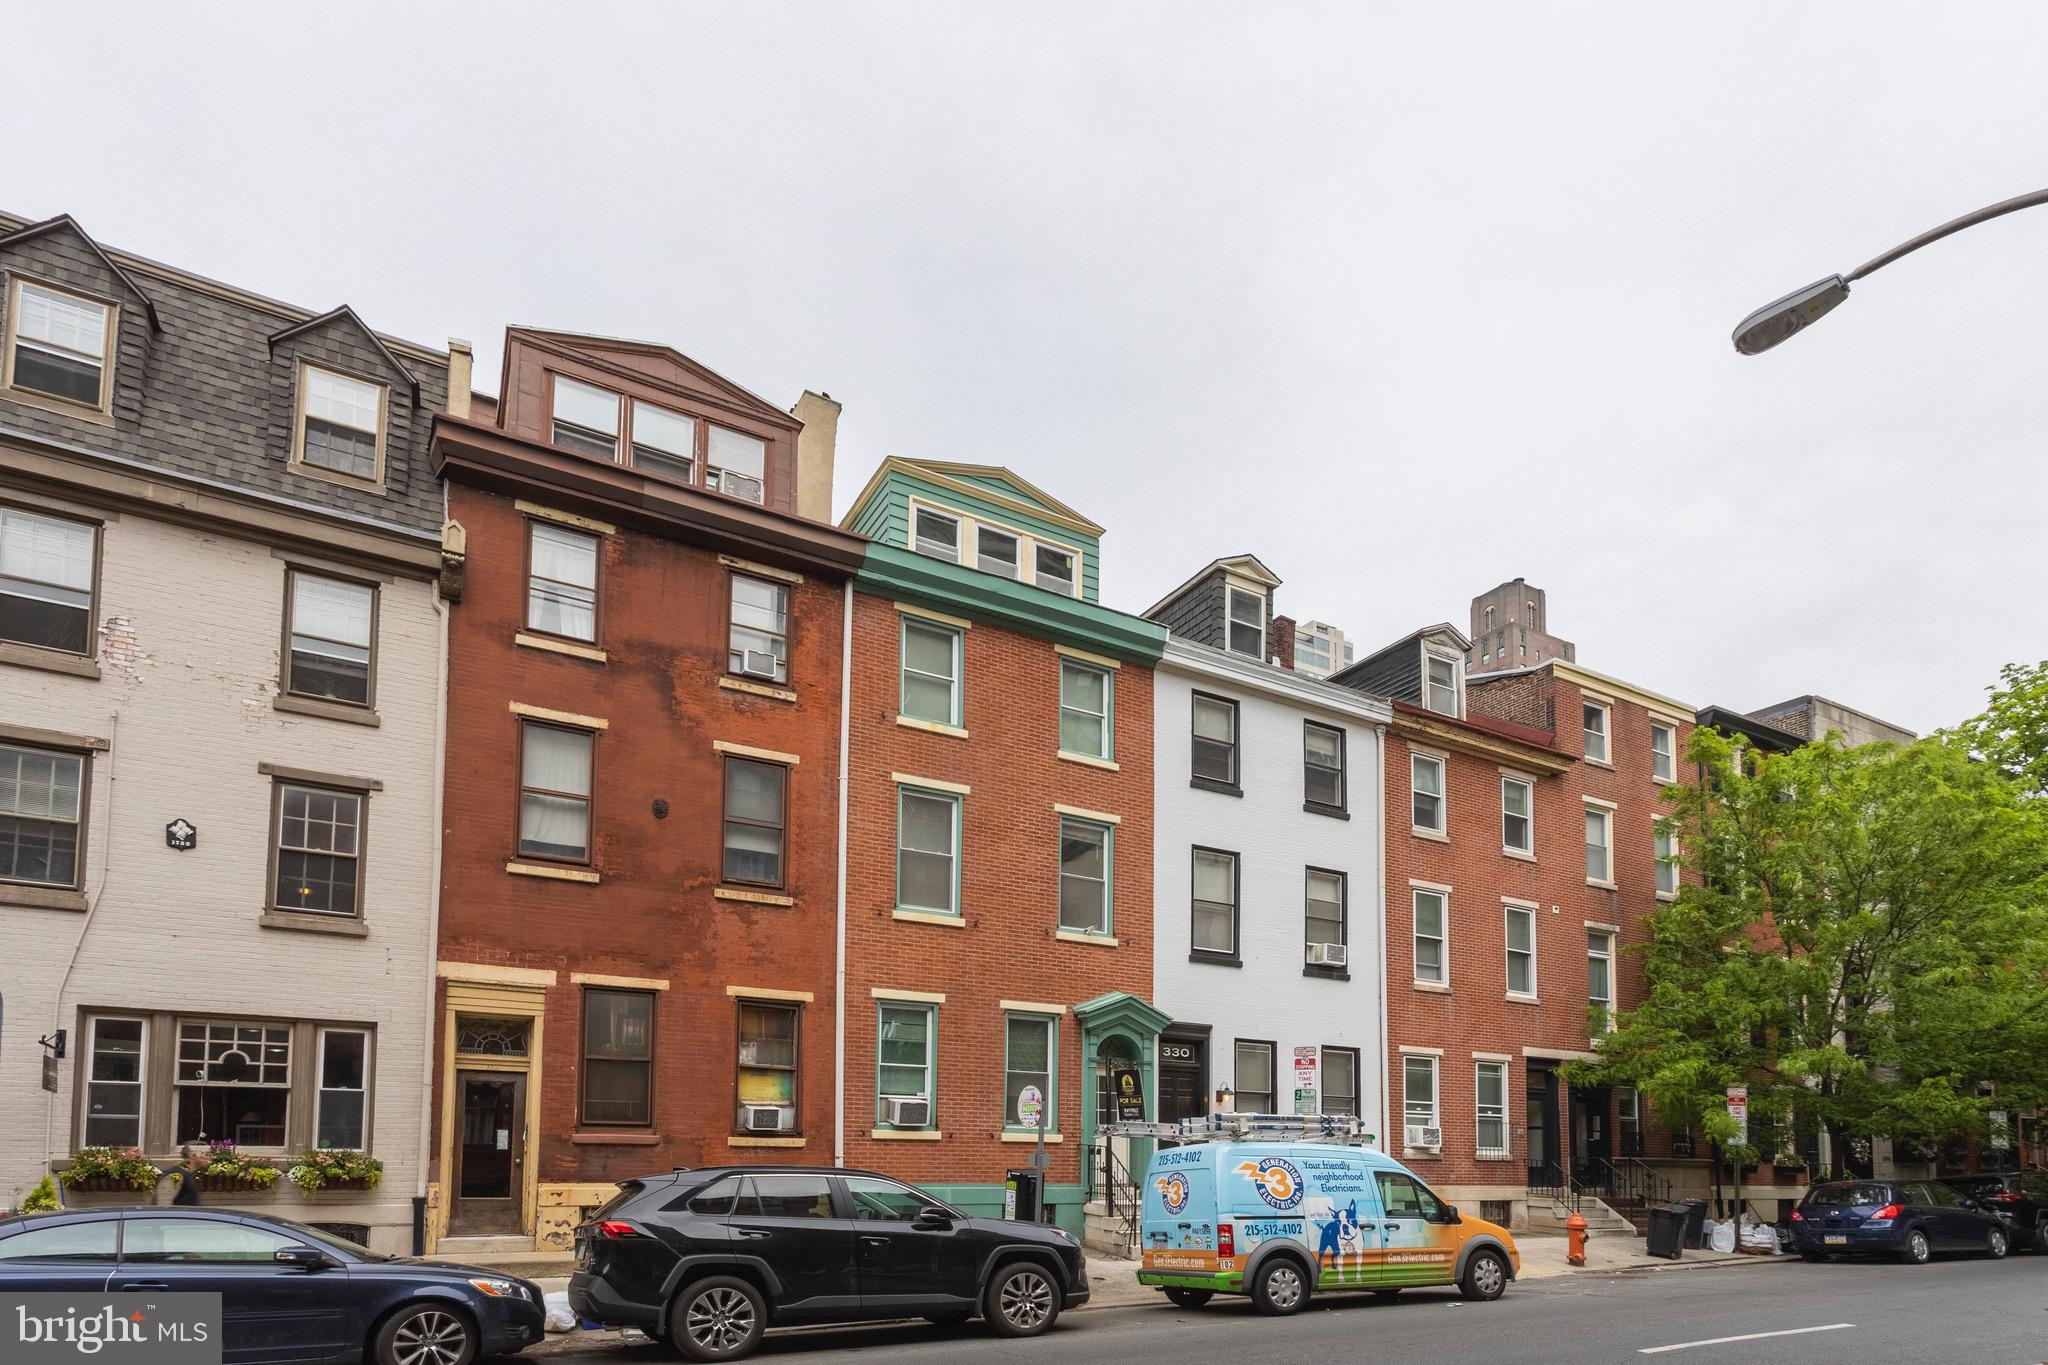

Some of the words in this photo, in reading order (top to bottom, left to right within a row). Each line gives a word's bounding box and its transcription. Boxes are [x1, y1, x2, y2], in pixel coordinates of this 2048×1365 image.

[1162, 1047, 1190, 1058] 330
[1159, 1151, 1201, 1165] 215-512-4102
[1262, 1158, 1302, 1184] GENERATION
[1303, 1161, 1321, 1169] Your
[1322, 1161, 1350, 1171] friendly
[1269, 1169, 1292, 1197] 3
[1313, 1172, 1364, 1182] neighborhood
[1170, 1181, 1182, 1205] 3
[1321, 1183, 1364, 1193] Electricians.
[1245, 1223, 1302, 1236] 215-512-4102
[1153, 1254, 1205, 1269] Gen3Electric.com
[1387, 1252, 1445, 1264] Gen3Electric.com
[1221, 1260, 1234, 1269] 102
